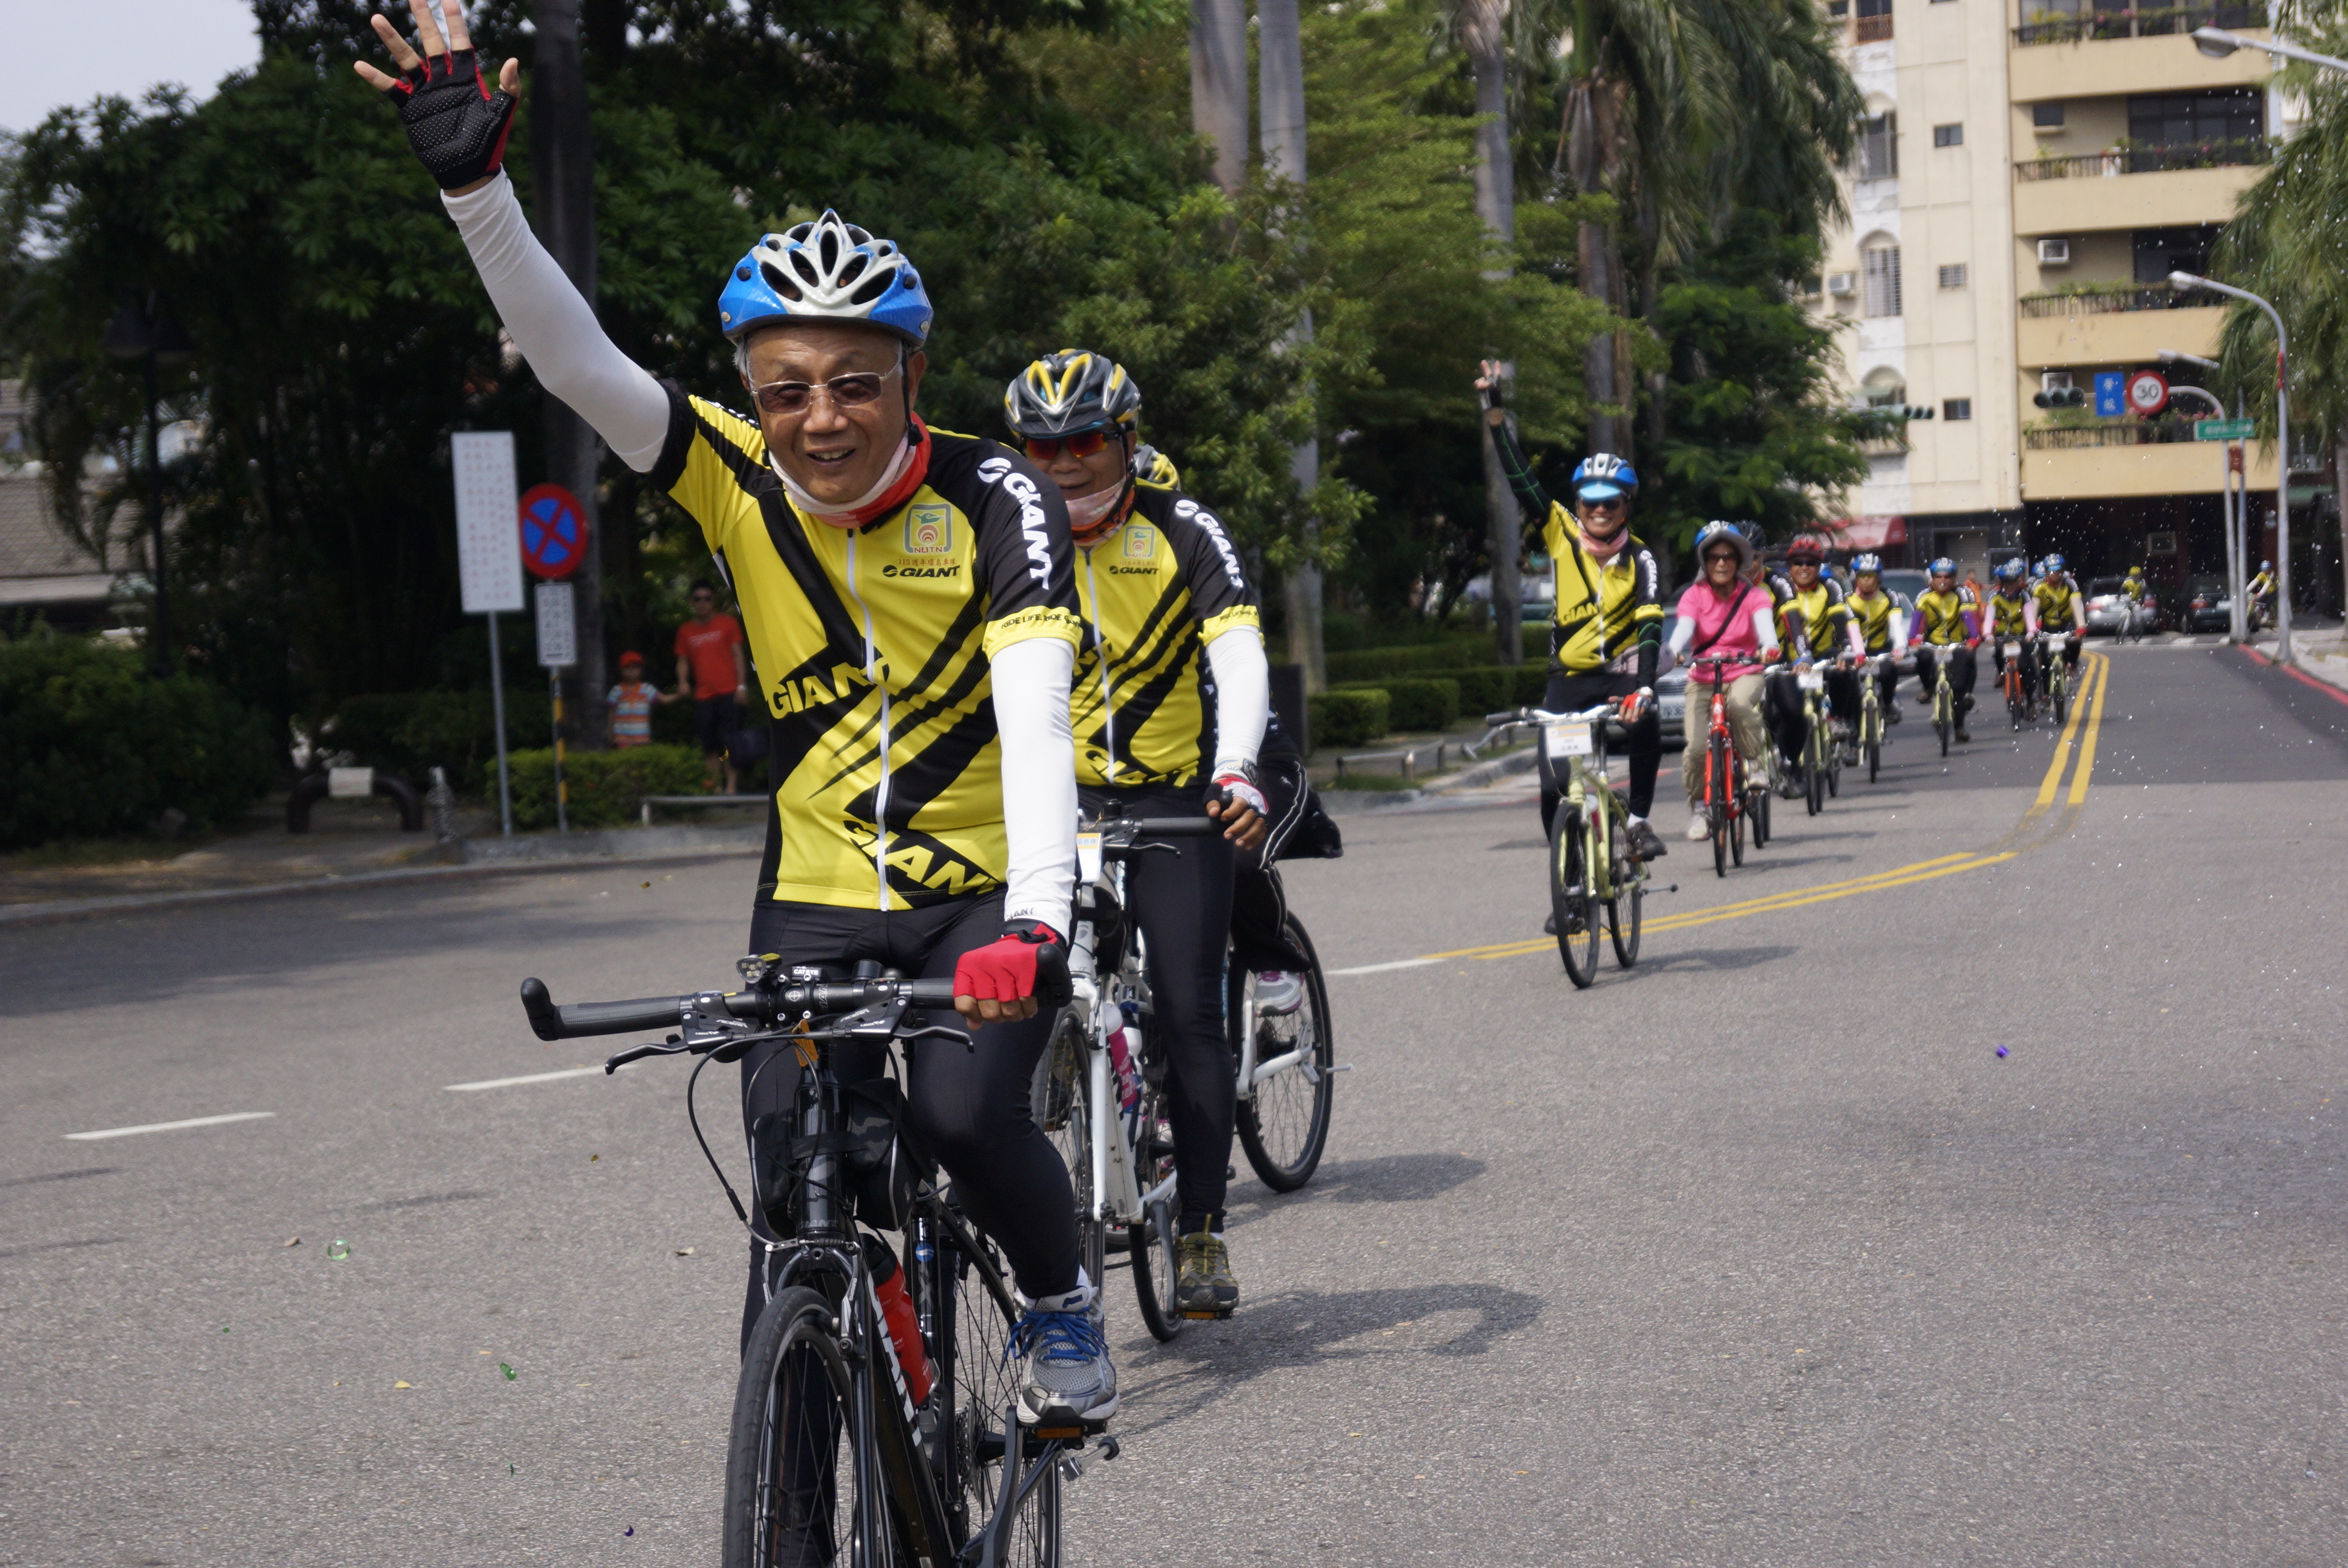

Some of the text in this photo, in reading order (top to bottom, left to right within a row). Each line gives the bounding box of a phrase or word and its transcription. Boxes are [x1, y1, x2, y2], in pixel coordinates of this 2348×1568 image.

[2136, 384, 2159, 400] 30
[1003, 472, 1053, 590] GIANT
[899, 565, 961, 577] GIANT
